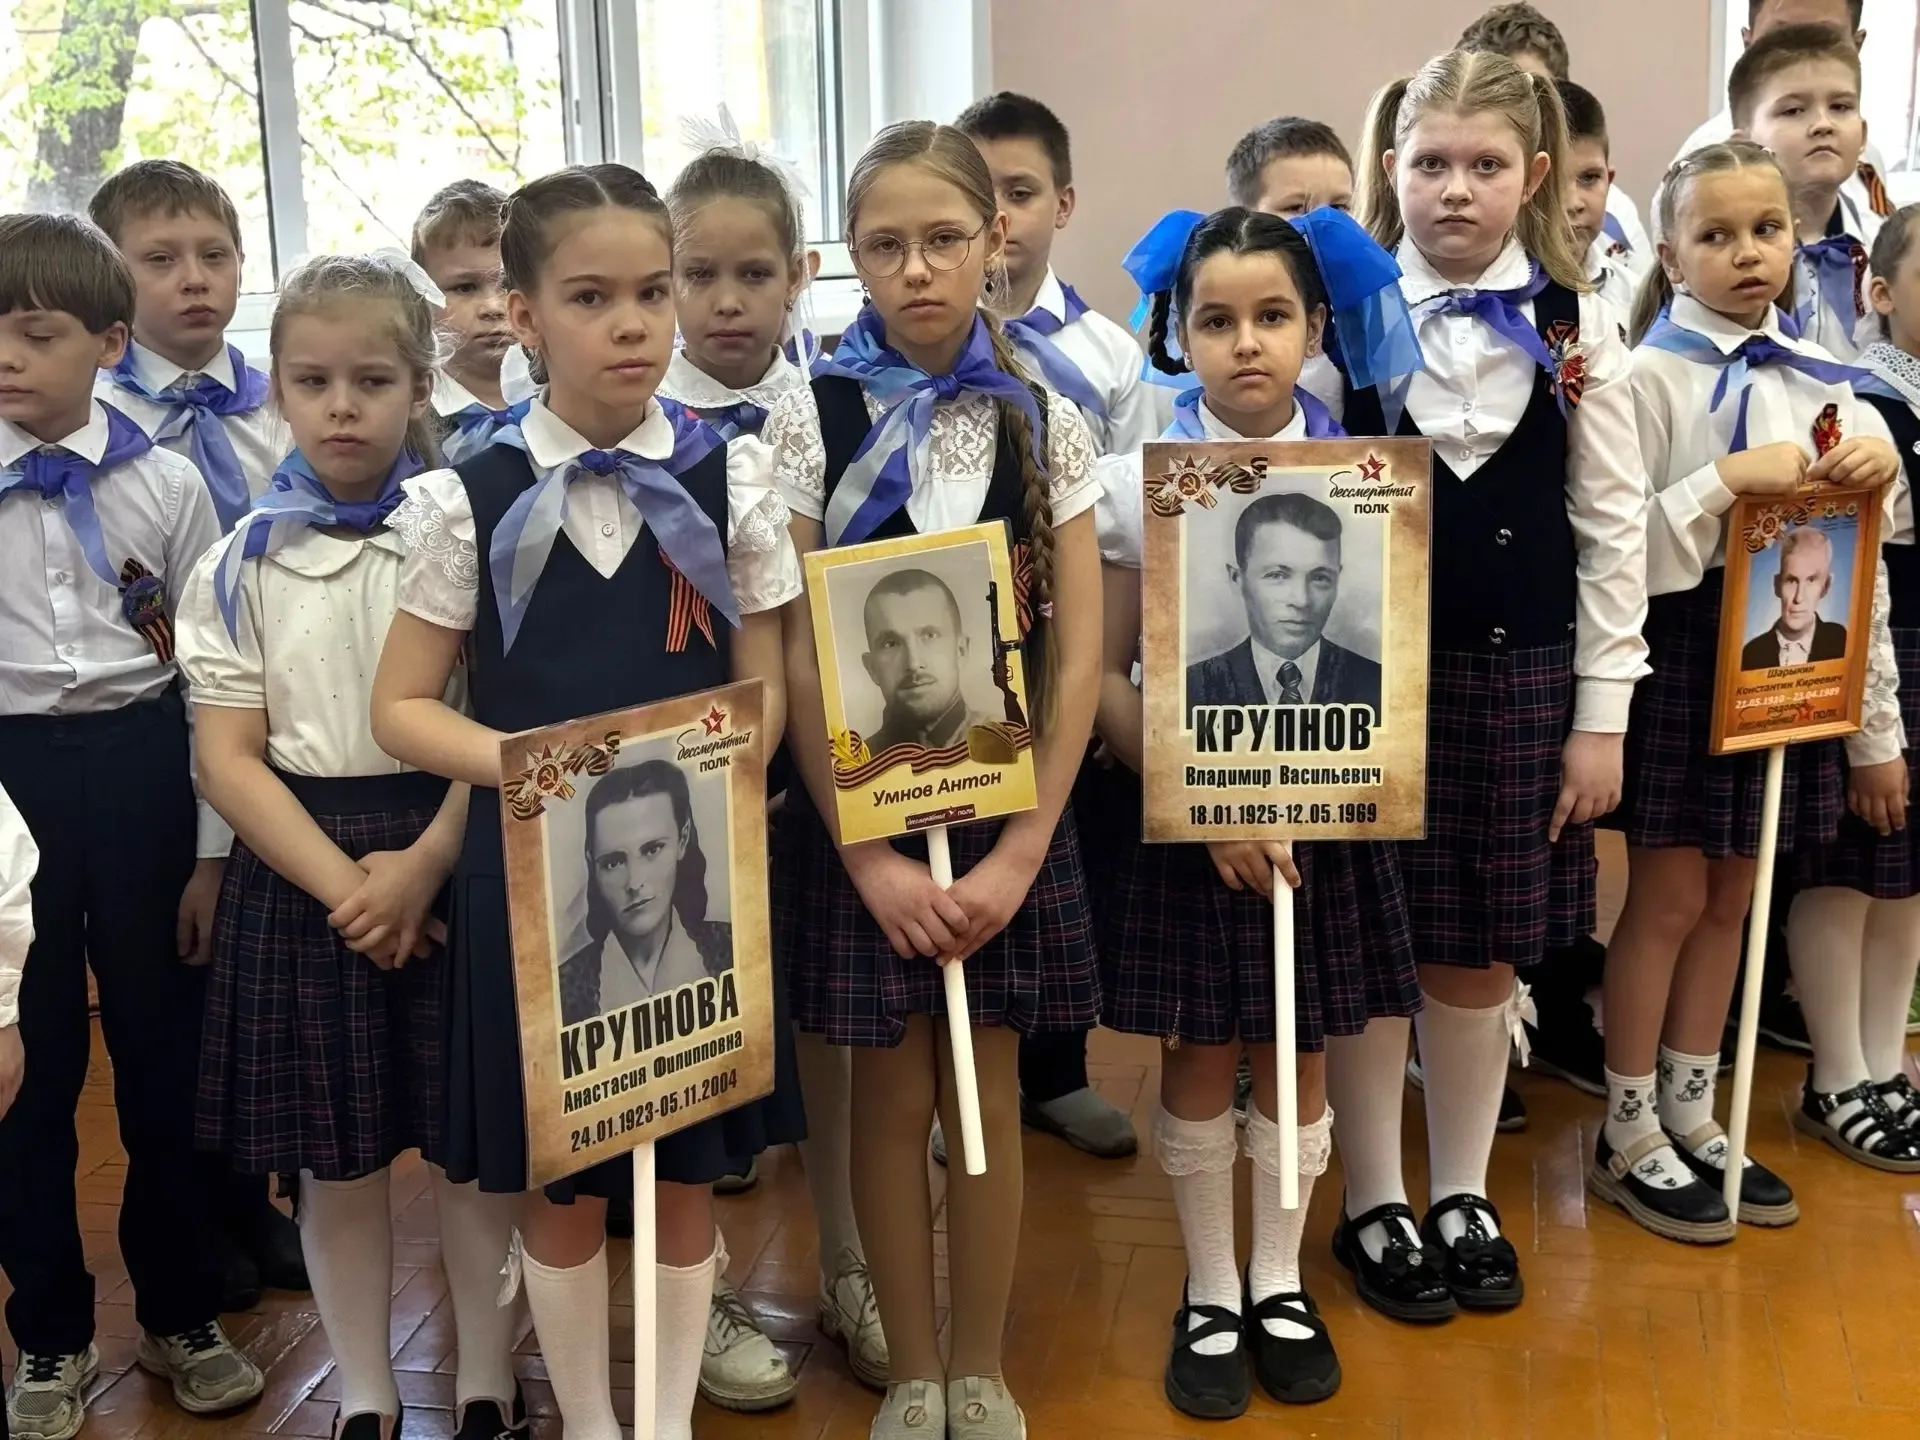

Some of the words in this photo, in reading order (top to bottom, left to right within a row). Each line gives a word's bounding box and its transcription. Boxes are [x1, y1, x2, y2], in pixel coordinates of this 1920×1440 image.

[1353, 503, 1390, 515] ПОЛК
[1736, 682, 1793, 696] Константин
[1196, 707, 1371, 753] КРУПНОВ
[699, 755, 731, 773] ПОЛК
[1185, 766, 1272, 788] Владимир
[1279, 765, 1381, 785] Васильевич
[873, 784, 933, 807] Умнов
[936, 771, 1002, 795] Антон
[1189, 803, 1377, 825] 18.01.1925-12.05.1969
[560, 972, 740, 1080] КРУПНОВА
[563, 1066, 647, 1115] Анастасия
[653, 1030, 743, 1079] Филипповна
[571, 1068, 738, 1153] 24.01.1923-05.11.2004
